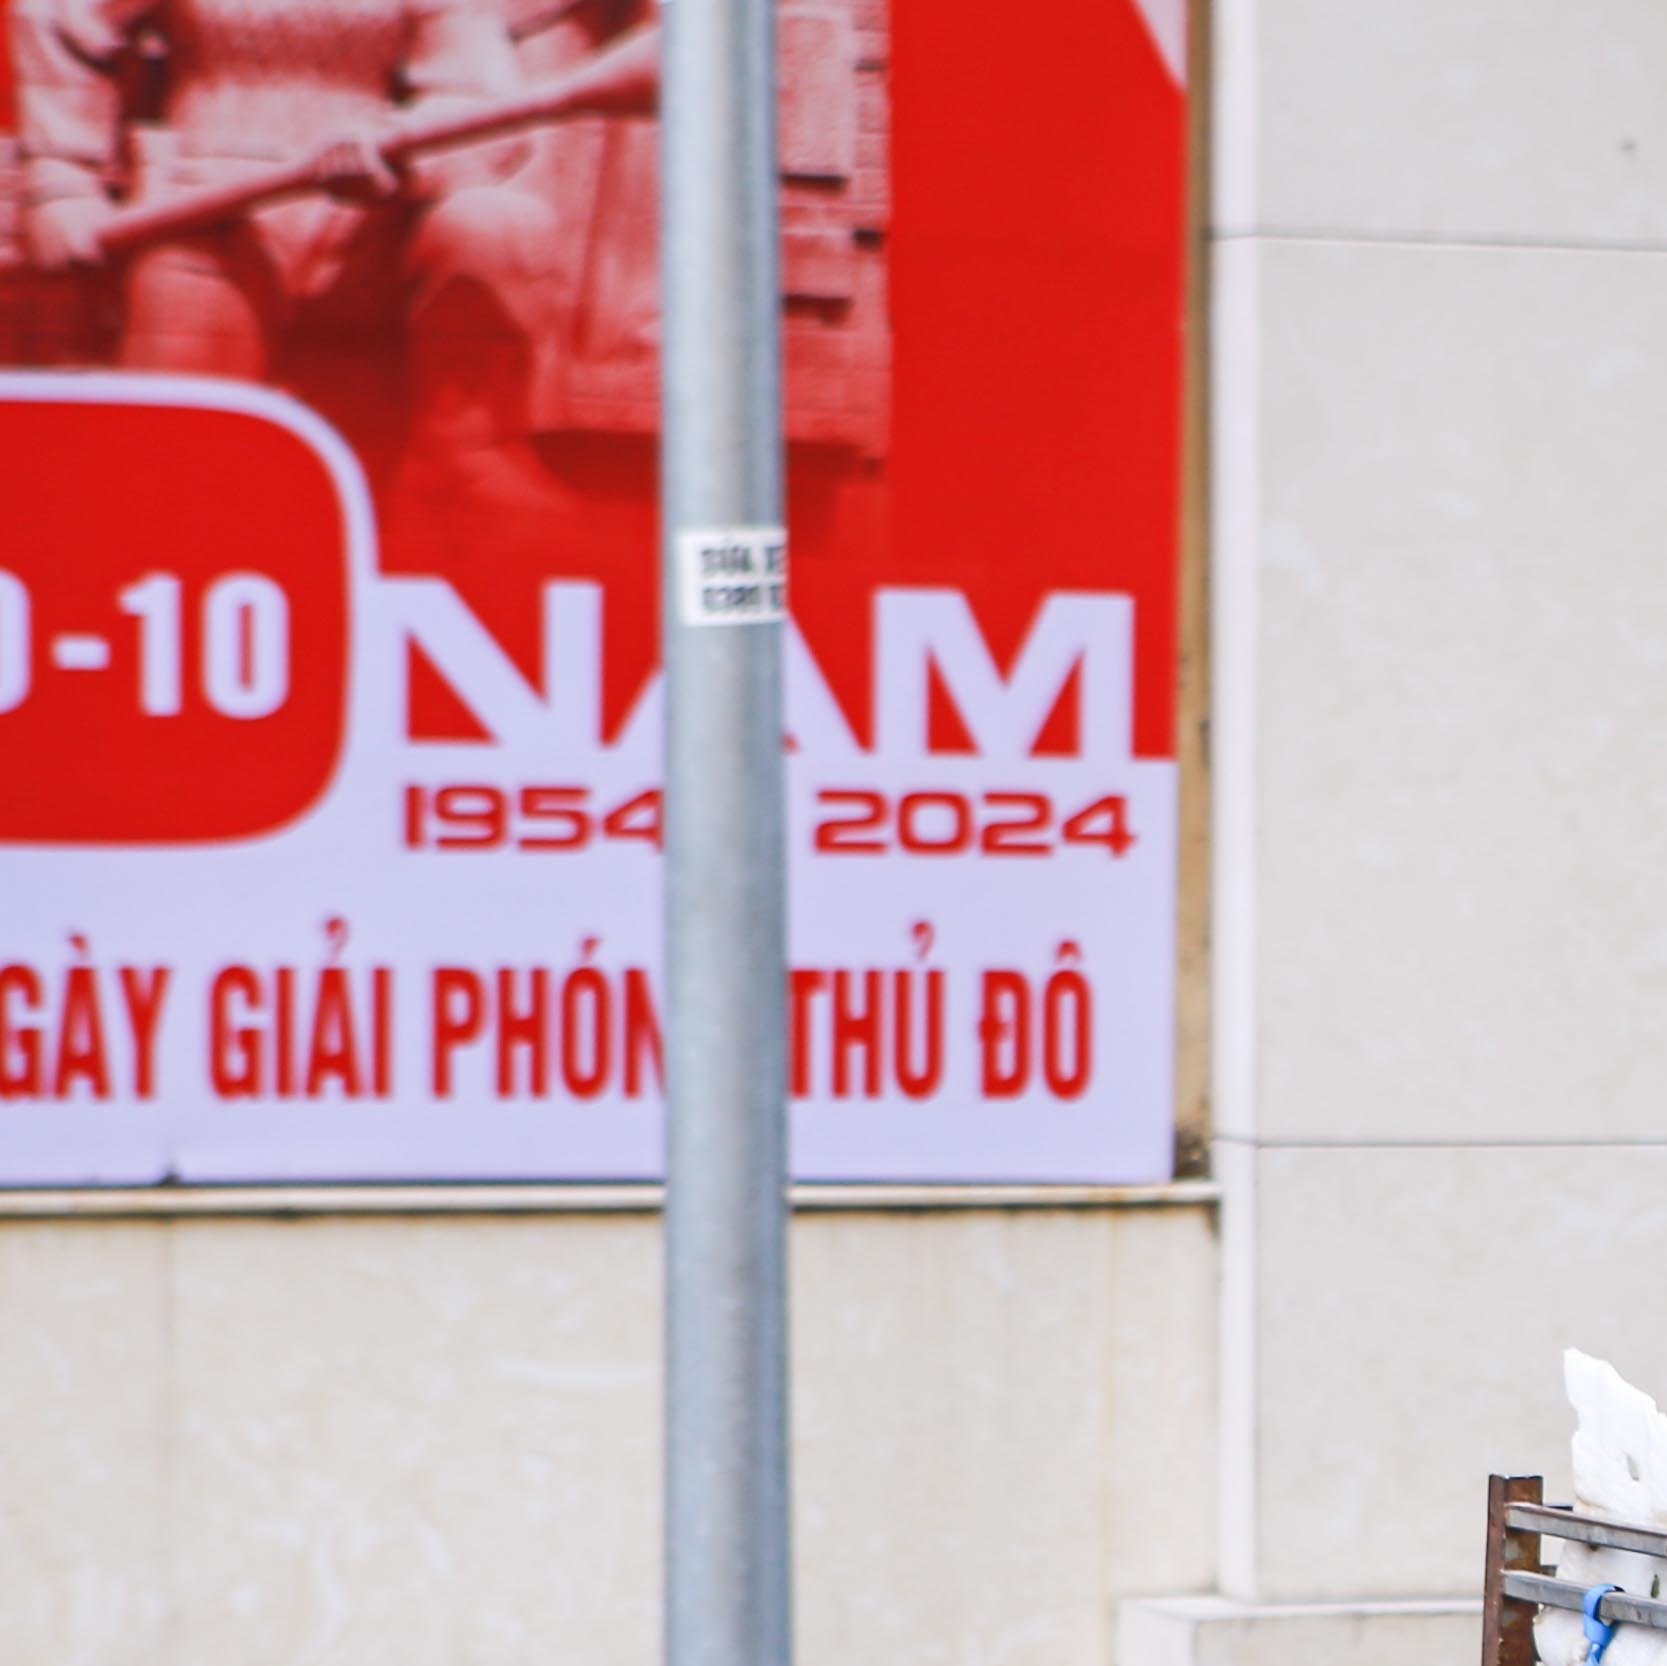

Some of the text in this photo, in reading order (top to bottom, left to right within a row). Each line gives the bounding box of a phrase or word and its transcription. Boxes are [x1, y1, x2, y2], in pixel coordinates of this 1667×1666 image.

[403, 785, 1136, 857] 1954 2024
[209, 916, 390, 1101] GIẢI
[787, 921, 943, 1101] THỦ
[979, 940, 1092, 1101] ĐÔ
